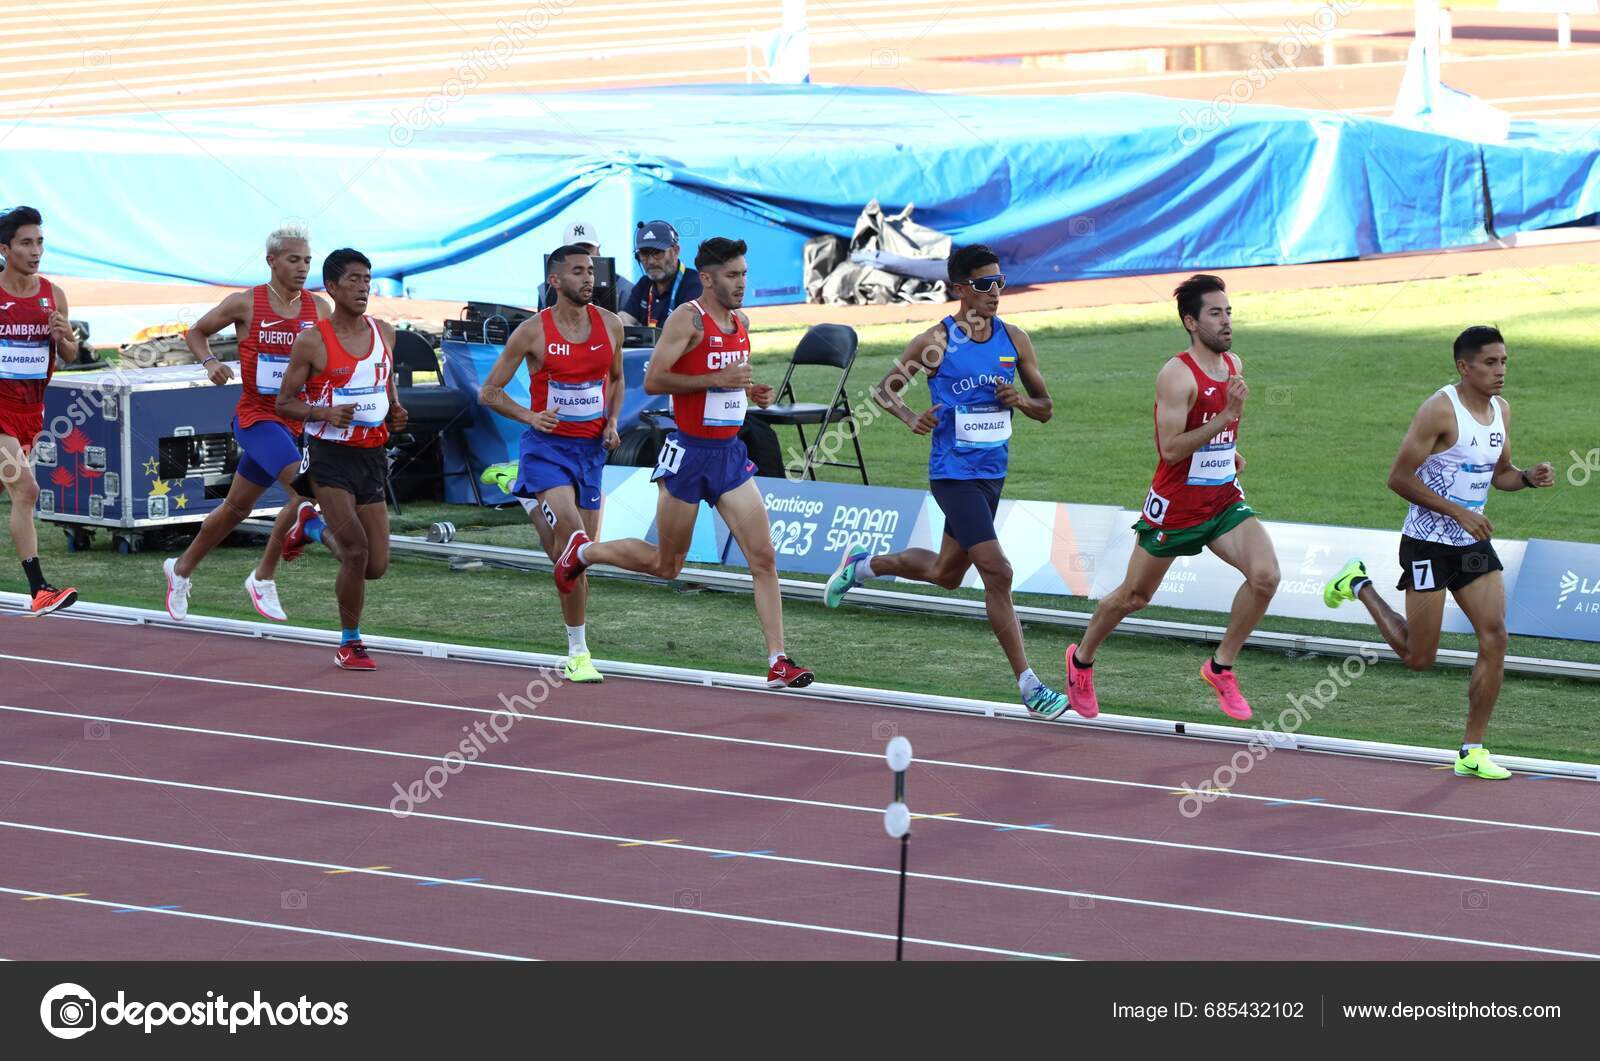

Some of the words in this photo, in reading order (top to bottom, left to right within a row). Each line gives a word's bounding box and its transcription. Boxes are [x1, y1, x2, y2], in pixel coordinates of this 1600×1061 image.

[259, 330, 294, 345] PUERTO
[548, 343, 571, 357] CHI
[2, 355, 45, 364] ZAMBRANO
[354, 403, 377, 411] OJAS
[553, 395, 600, 406] VELÁSQUEZ
[724, 399, 741, 409] DÍAZ
[964, 421, 1005, 432] GONZALEZ
[661, 443, 678, 467] 11
[542, 503, 555, 525] 5
[764, 493, 824, 518] Santiago
[1145, 492, 1163, 519] 10
[831, 505, 899, 533] PANAM
[767, 520, 818, 556] 023
[1414, 563, 1429, 586] 7
